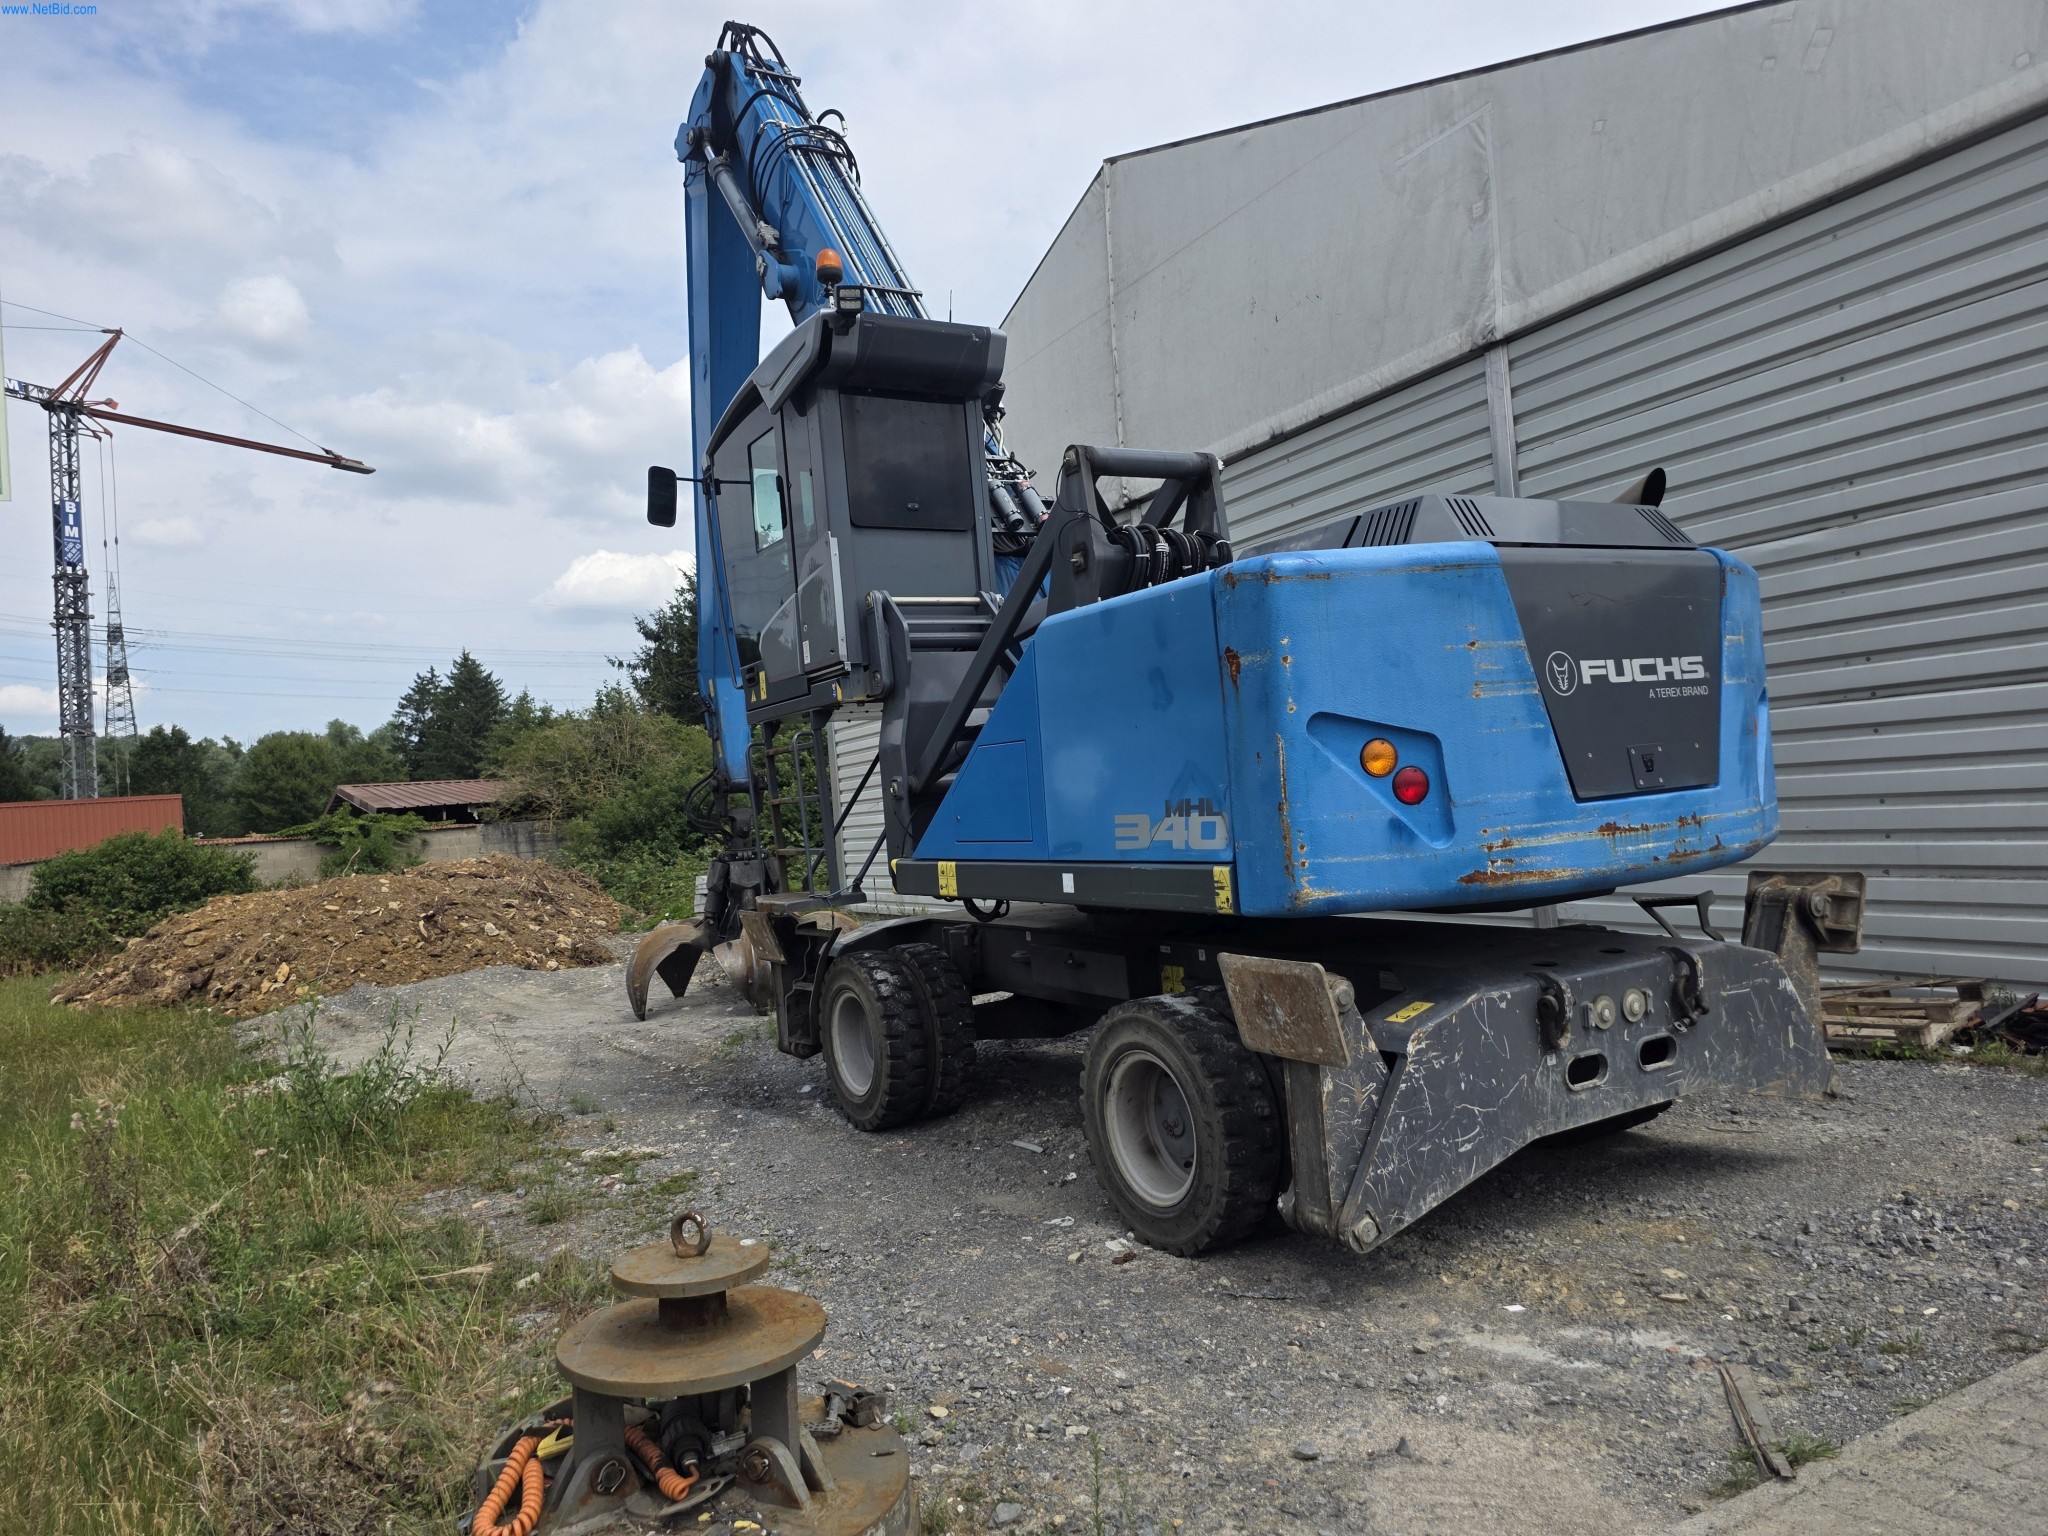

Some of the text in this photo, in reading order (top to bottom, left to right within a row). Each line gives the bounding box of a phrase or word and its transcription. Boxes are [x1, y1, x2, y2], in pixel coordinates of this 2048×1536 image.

[64, 501, 79, 538] BIM
[1580, 656, 1705, 685] FUCHS
[1649, 685, 1709, 699] A TEREX BRAND
[1165, 797, 1223, 817] MHL
[1115, 812, 1230, 850] 340
